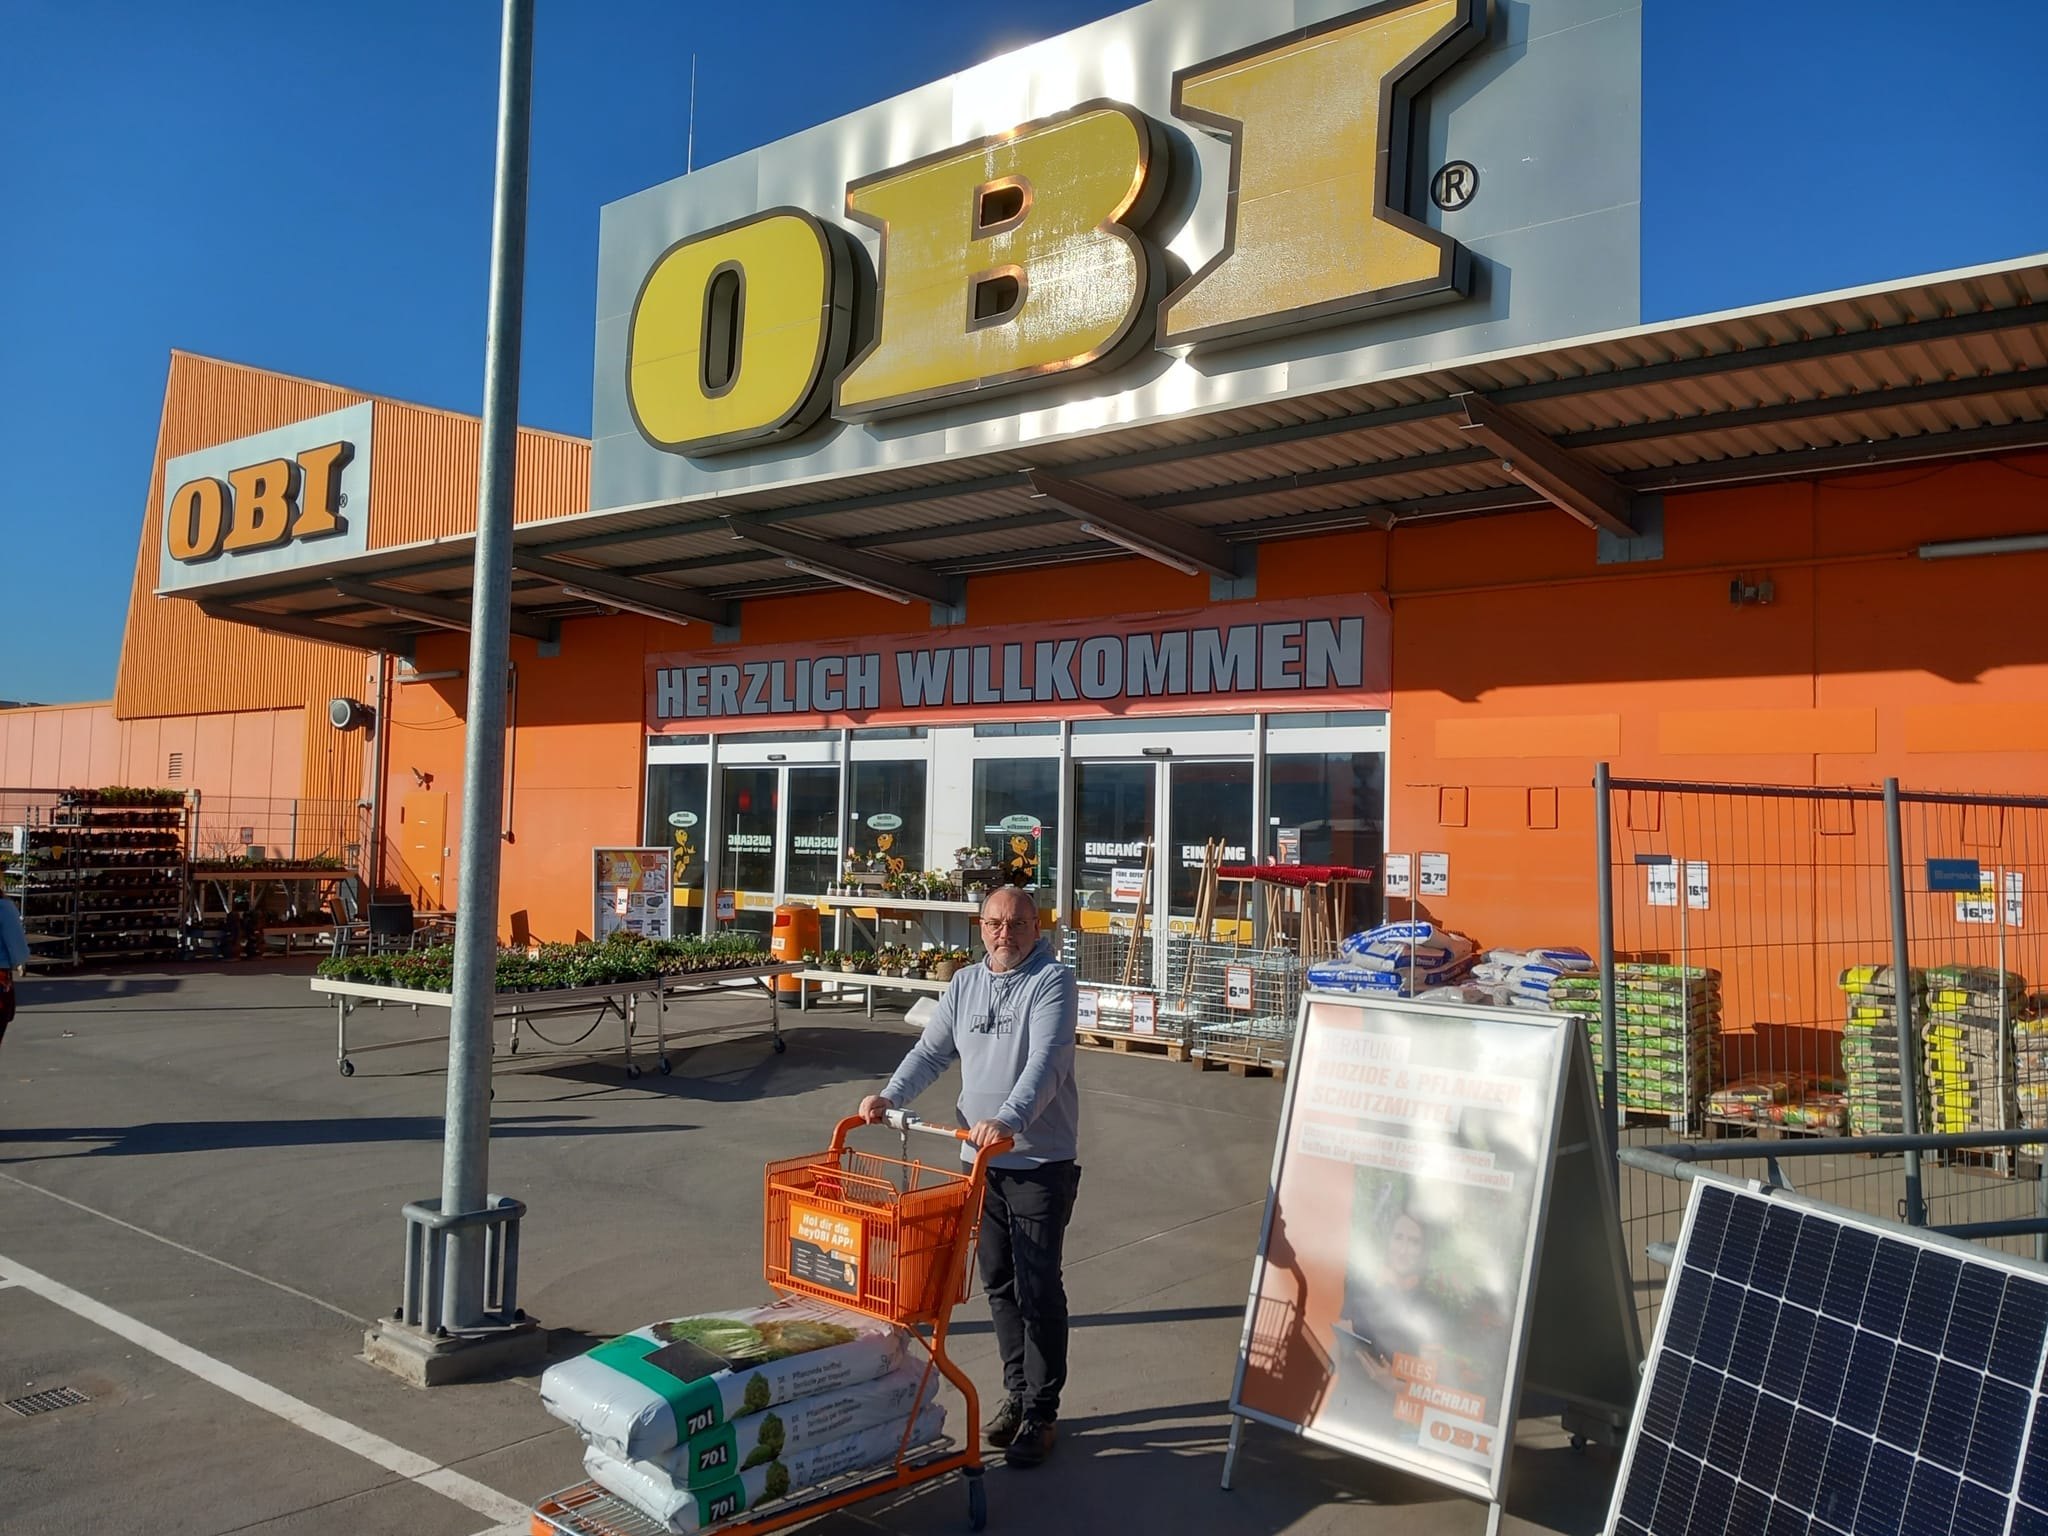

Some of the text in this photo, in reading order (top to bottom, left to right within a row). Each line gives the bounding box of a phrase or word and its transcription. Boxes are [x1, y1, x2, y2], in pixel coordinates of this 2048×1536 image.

[626, 0, 1487, 457] OBI
[168, 441, 354, 563] OBI
[656, 616, 1365, 719] HERZLICH WILLKOMMEN
[1085, 842, 1142, 857] EINGANG
[1182, 845, 1246, 860] EINANG
[1421, 872, 1446, 885] 3.79
[1228, 986, 1249, 998] 6.99
[802, 1213, 850, 1236] Hol dir die
[1397, 1358, 1433, 1380] ALLES
[1399, 1400, 1420, 1417] MIT
[1408, 1382, 1481, 1416] MACHBAR
[1430, 1420, 1493, 1456] OBI
